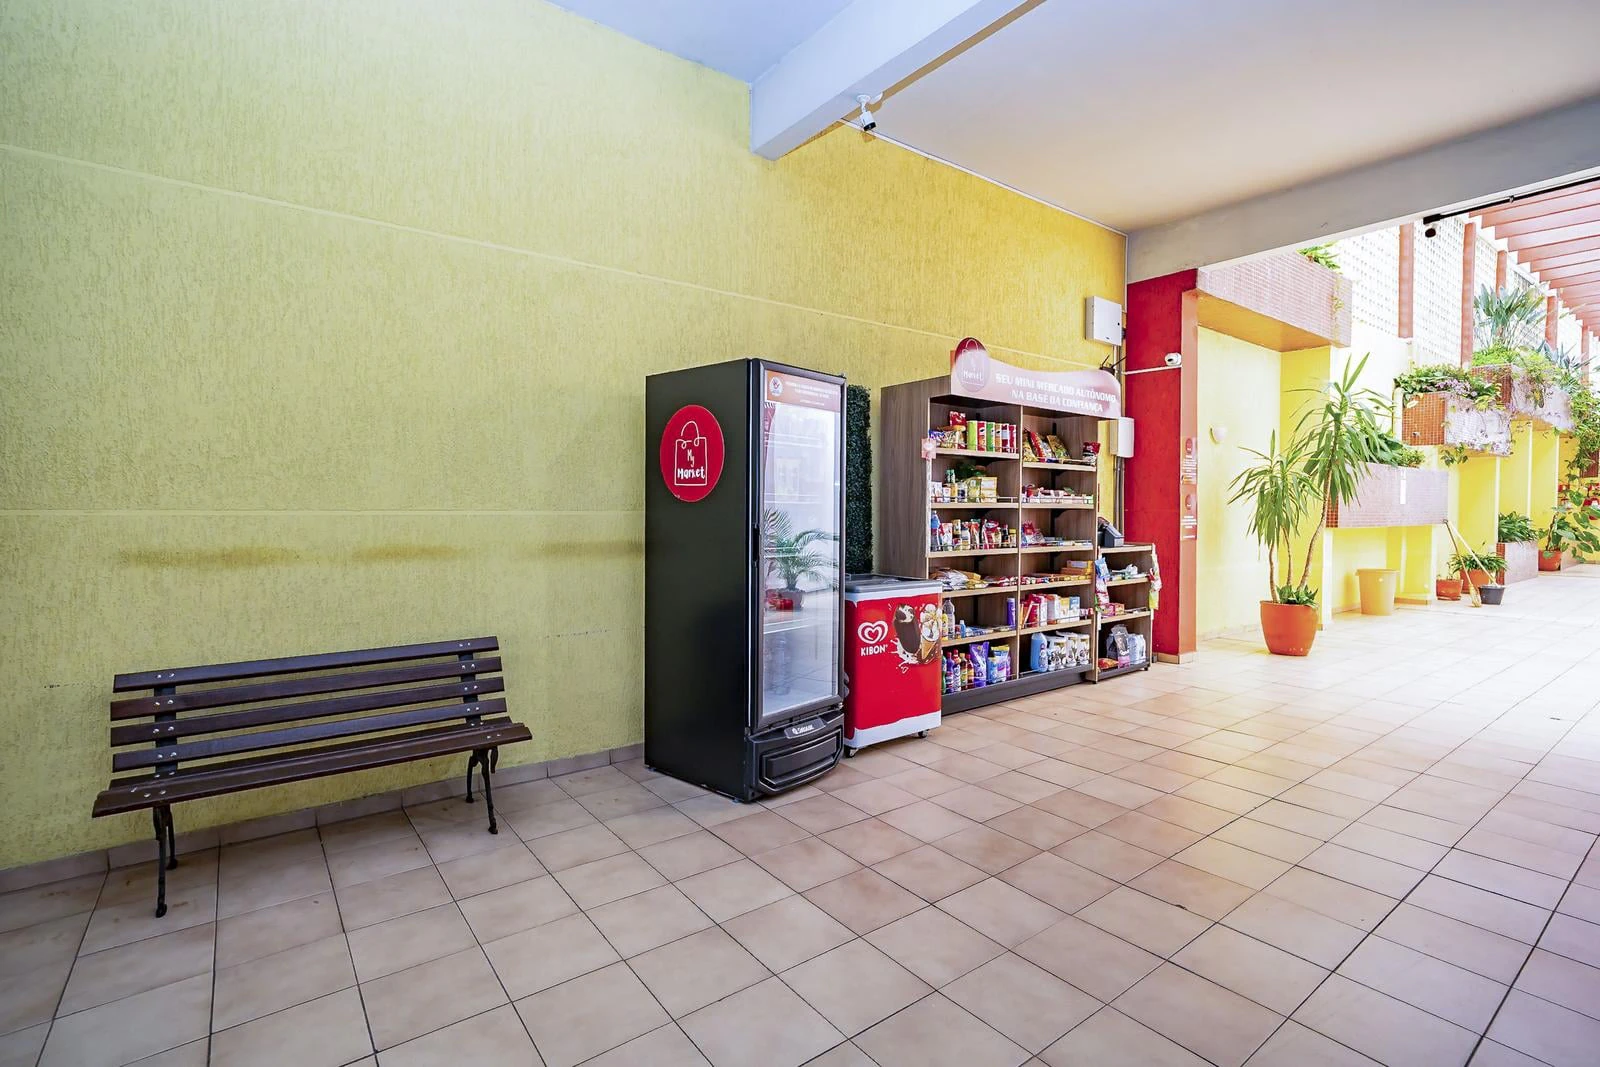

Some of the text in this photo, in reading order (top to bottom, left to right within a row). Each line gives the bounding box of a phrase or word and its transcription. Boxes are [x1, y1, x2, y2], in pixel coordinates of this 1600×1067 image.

[995, 373, 1117, 403] SEU MINI MERCADO AUTÔNOMO
[1011, 389, 1104, 412] NA BASE DA CONFIANÇA
[687, 449, 695, 468] My
[677, 466, 706, 479] Market
[861, 645, 886, 656] KIBON
